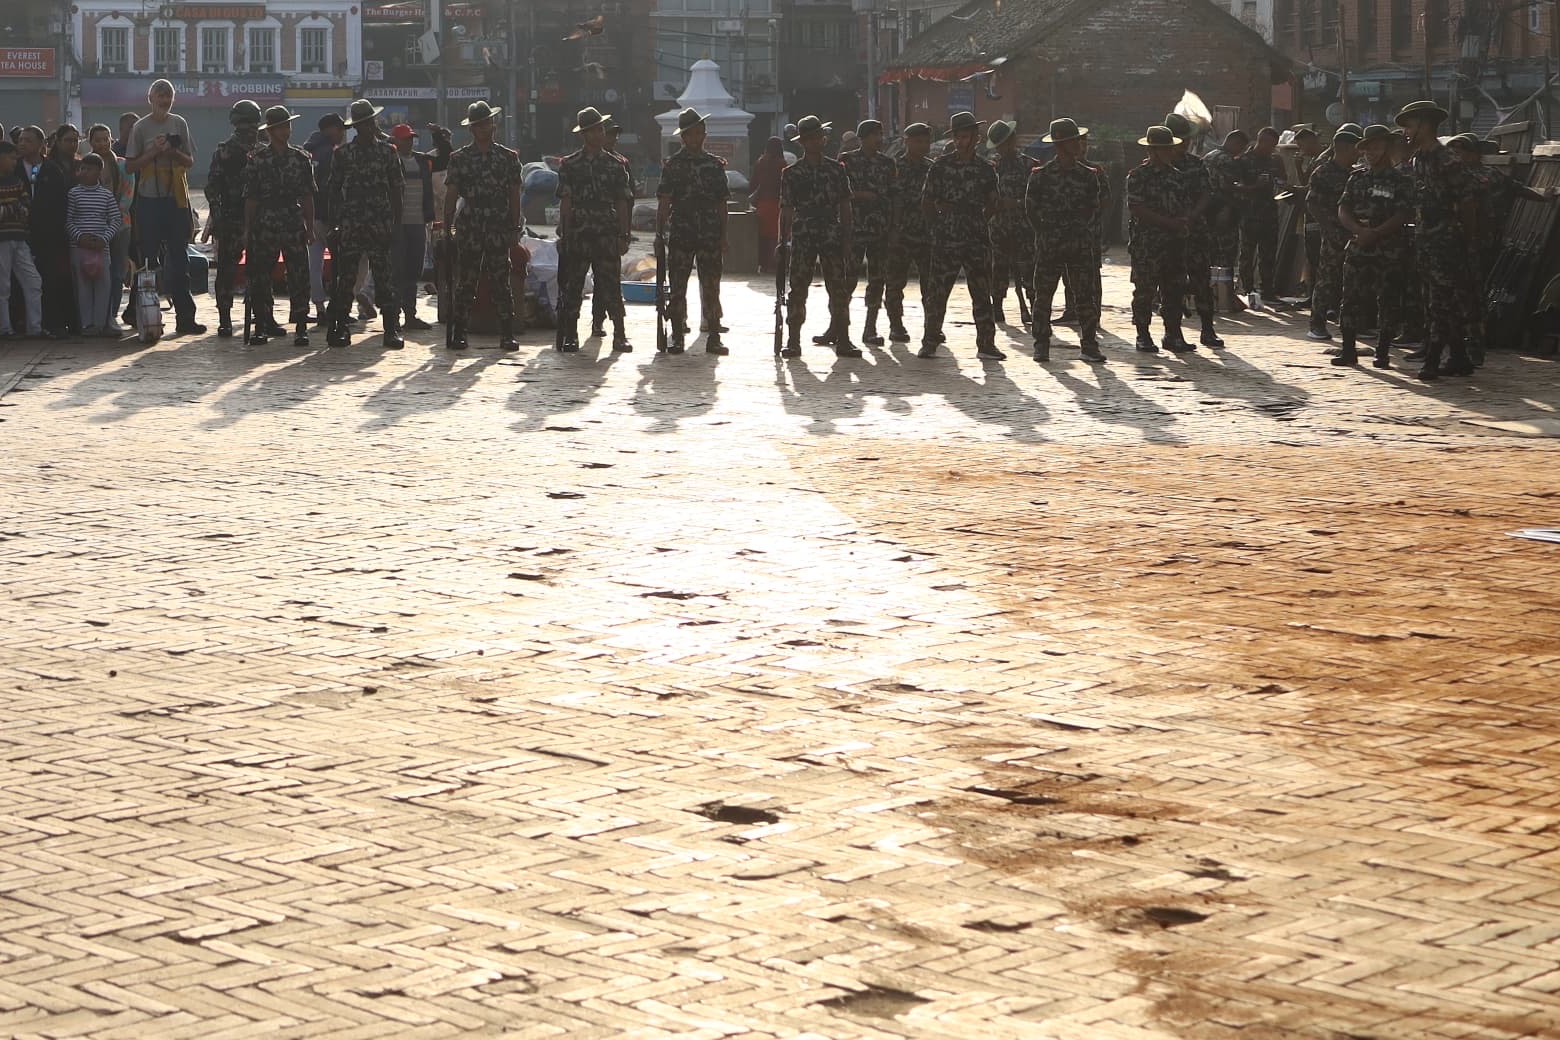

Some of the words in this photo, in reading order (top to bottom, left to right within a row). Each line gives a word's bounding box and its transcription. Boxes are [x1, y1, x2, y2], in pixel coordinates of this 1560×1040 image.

[7, 51, 41, 60] EVEREST
[1, 61, 16, 70] TEA
[18, 61, 47, 70] HOUSE
[232, 83, 282, 94] ROBBINS
